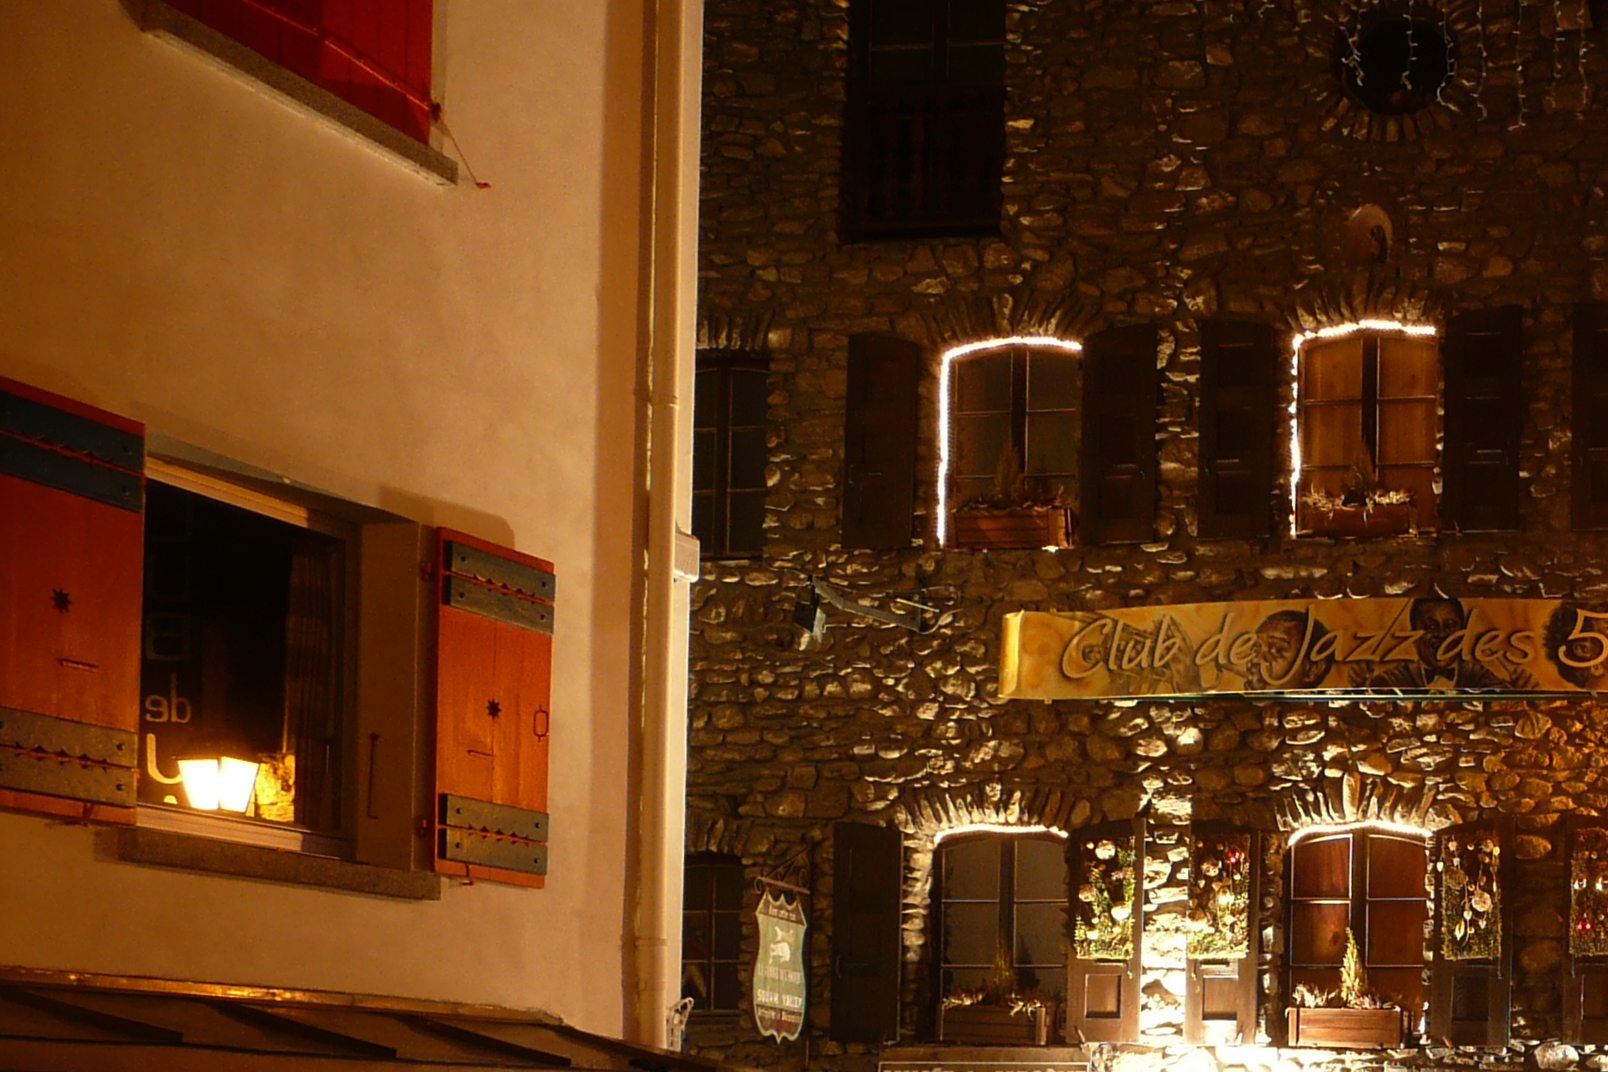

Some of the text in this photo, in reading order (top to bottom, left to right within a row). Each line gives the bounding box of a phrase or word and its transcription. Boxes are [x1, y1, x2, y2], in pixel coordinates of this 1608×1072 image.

[1060, 615, 1182, 680] Club
[1194, 612, 1257, 666] de
[1259, 598, 1425, 685] Jazz
[1436, 608, 1535, 664] des
